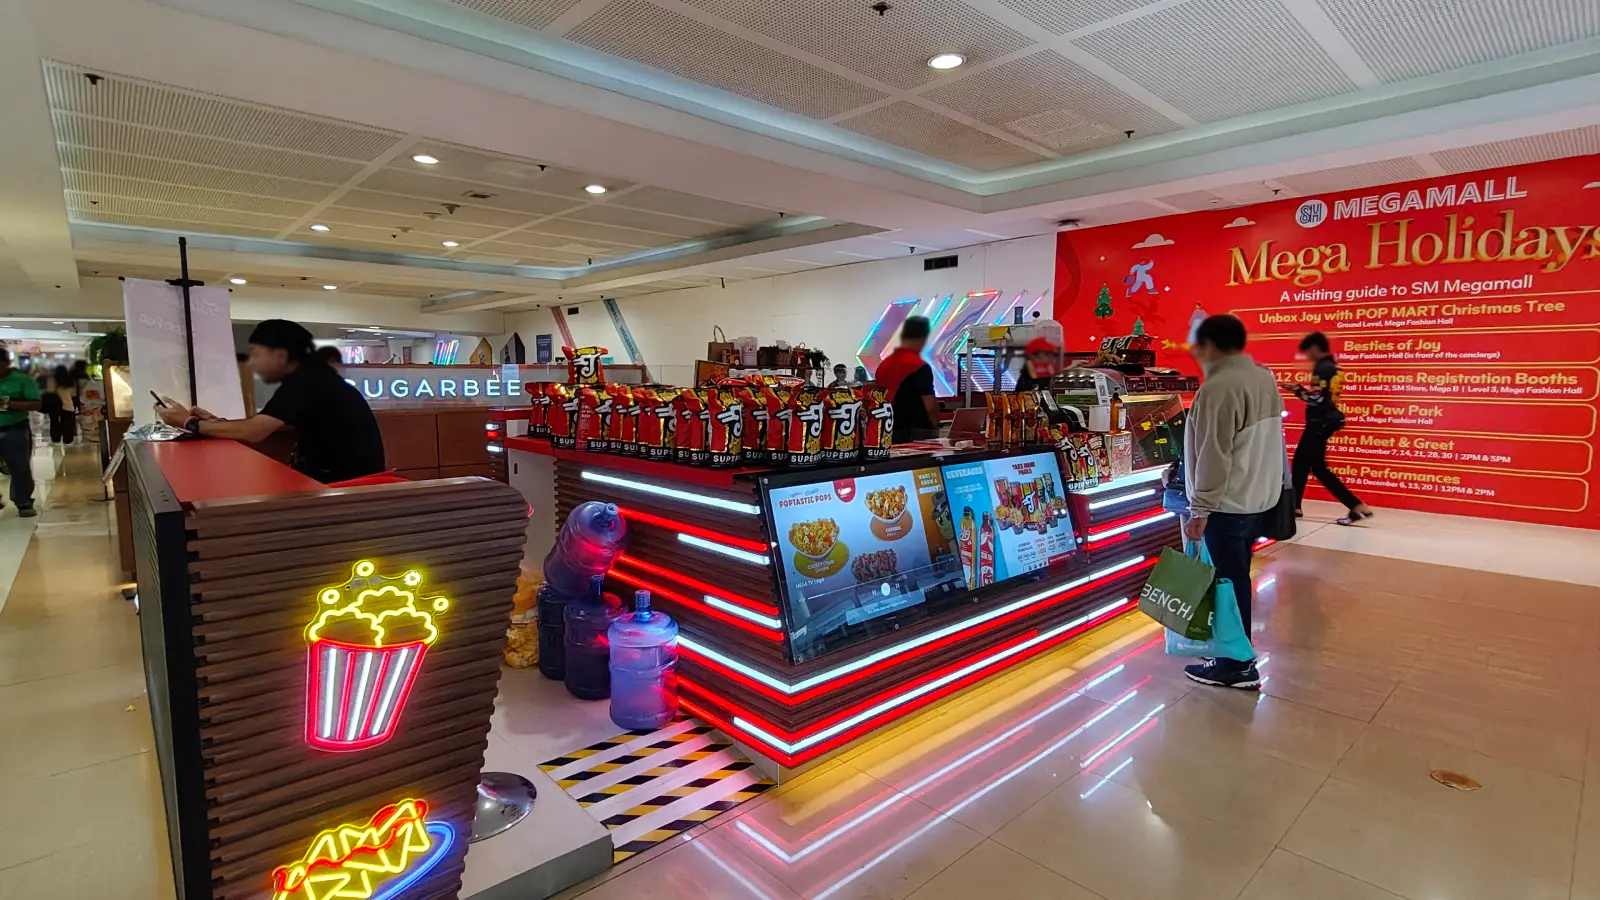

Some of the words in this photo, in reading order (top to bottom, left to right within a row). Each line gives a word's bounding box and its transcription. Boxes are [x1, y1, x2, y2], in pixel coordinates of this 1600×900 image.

[1299, 203, 1323, 225] SM
[1333, 176, 1528, 221] MEGAMALL
[1225, 239, 1351, 287] Mega
[1279, 290, 1291, 303] A
[1293, 288, 1342, 302] visiting
[1345, 285, 1388, 301] guide
[1391, 284, 1407, 296] to
[1411, 280, 1439, 295] SM
[1444, 274, 1533, 294] Megamall
[1259, 312, 1298, 324] Unbox
[1299, 311, 1321, 324] Joy
[1324, 309, 1353, 321] with
[1356, 307, 1389, 320] POP
[1392, 304, 1440, 318] MART
[1441, 302, 1522, 316] Christmas
[1525, 300, 1566, 313] Tree
[1336, 321, 1362, 329] Ground
[1362, 320, 1384, 328] Level,
[1384, 320, 1406, 328] Mega
[1406, 318, 1436, 326] Fashion
[1437, 317, 1454, 325] Hall
[1343, 340, 1395, 352] Besties
[1396, 339, 1413, 351] of
[1414, 338, 1441, 353] Joy
[1338, 353, 1359, 361] Mega
[1359, 352, 1387, 360] Fashion
[1404, 352, 1414, 360] (in
[1458, 351, 1501, 360] concierge)
[1276, 371, 1292, 382] 12
[1344, 371, 1413, 384] Christmas
[1416, 371, 1511, 386] Registration
[1515, 372, 1578, 385] Booths
[1405, 385, 1429, 393] Store,
[1429, 386, 1451, 394] Mega
[1467, 386, 1490, 394] Level
[1490, 386, 1499, 394] 3,
[1500, 386, 1525, 395] Mega
[1526, 386, 1561, 395] Fashion
[1562, 387, 1583, 395] Hall
[1373, 404, 1405, 416] Paw
[1408, 404, 1444, 417] Park
[1366, 417, 1387, 425] Mega
[1388, 417, 1416, 425] Fashion
[1327, 435, 1357, 445] anta
[1360, 435, 1395, 447] Meet
[1398, 436, 1411, 448] &
[1413, 437, 1456, 451] Greet
[1337, 445, 1348, 453] 30
[1355, 446, 1392, 455] December
[1391, 448, 1399, 456] 7,
[1399, 449, 1412, 457] 14,
[1413, 450, 1426, 458] 21,
[1427, 451, 1440, 459] 28,
[1460, 453, 1481, 461] 2PM
[1481, 454, 1490, 462] &
[1490, 455, 1511, 463] 5PM
[1360, 466, 1461, 485] Performances
[1362, 479, 1399, 489] December
[1407, 482, 1421, 490] 13,
[1421, 483, 1433, 491] 20
[1440, 484, 1466, 494] 12PM
[1466, 486, 1474, 495] &
[1474, 488, 1495, 497] 2PM
[778, 494, 815, 508] POPTASTIC
[815, 493, 832, 503] POPS
